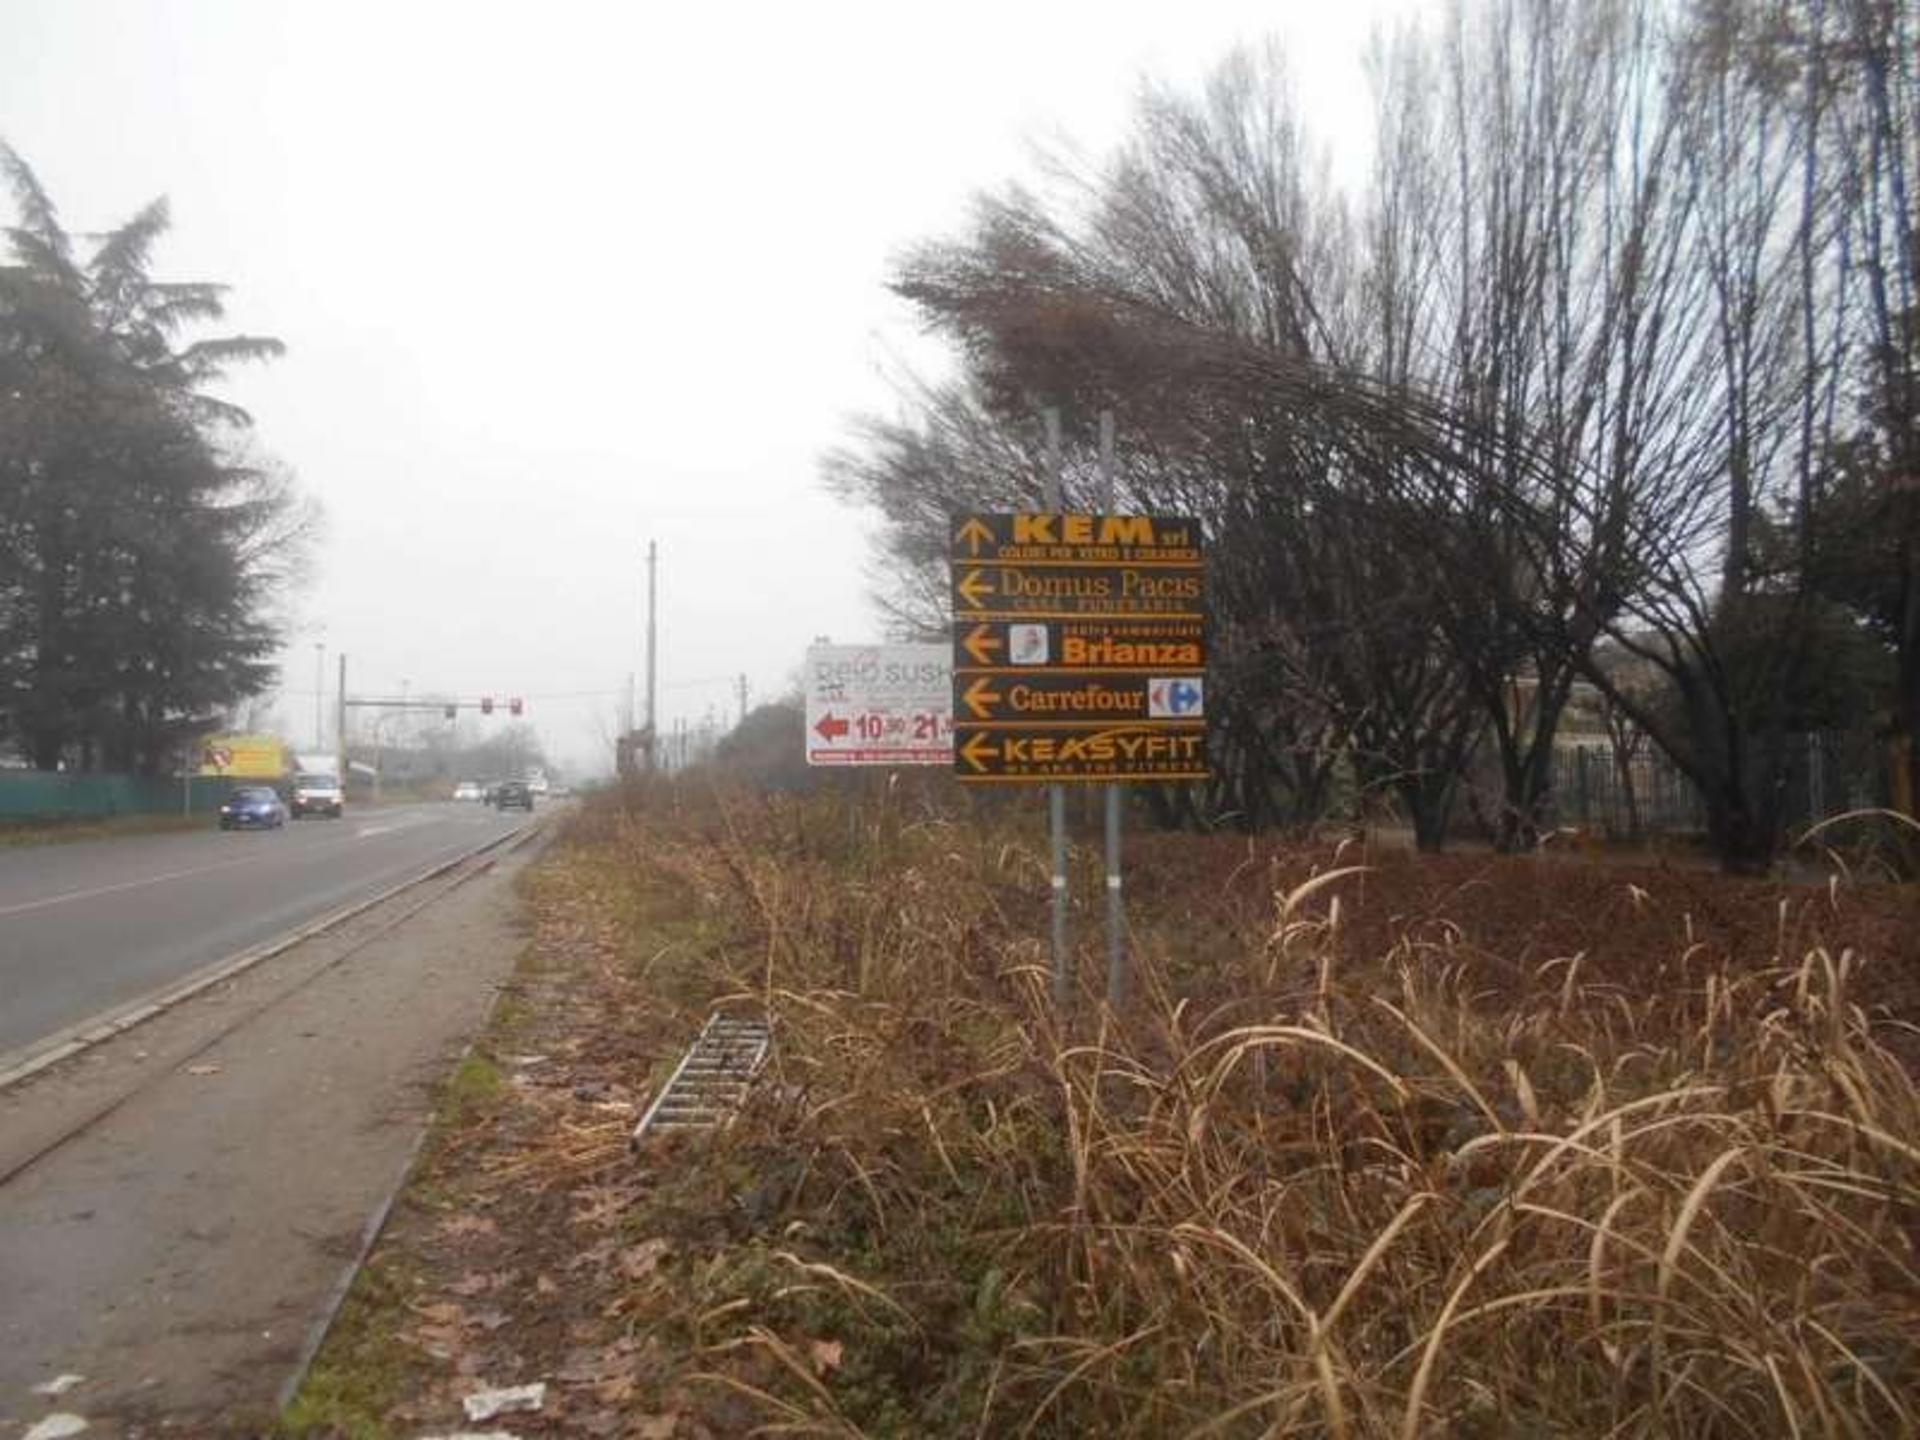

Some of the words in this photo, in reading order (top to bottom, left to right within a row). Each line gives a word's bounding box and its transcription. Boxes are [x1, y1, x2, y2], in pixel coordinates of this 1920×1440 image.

[1013, 514, 1154, 545] KEM
[1001, 569, 1110, 598] Domus
[1121, 569, 1200, 598] Pacis
[1061, 637, 1200, 665] Brianza
[1010, 683, 1144, 712] Carrefour
